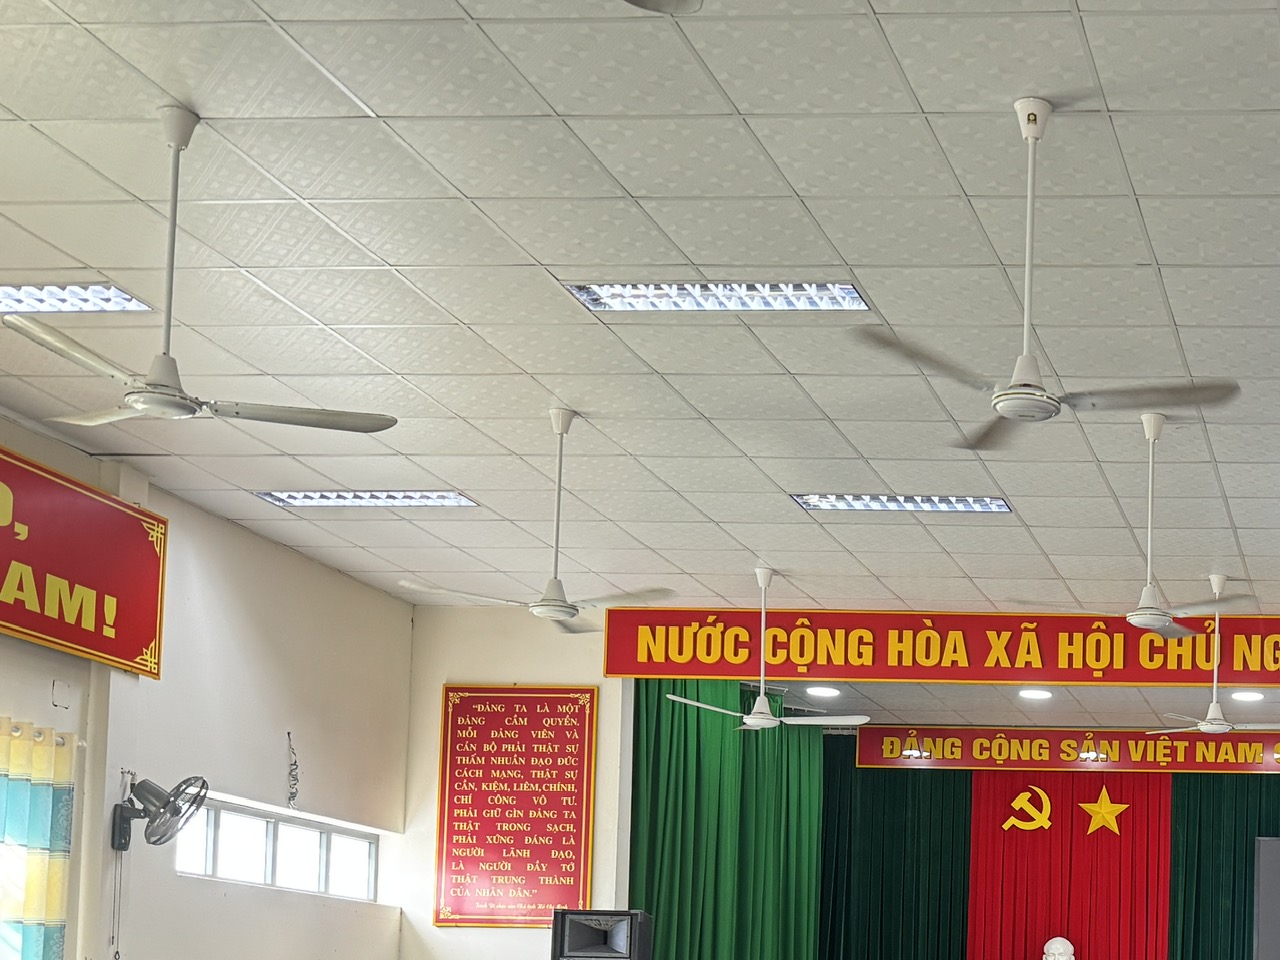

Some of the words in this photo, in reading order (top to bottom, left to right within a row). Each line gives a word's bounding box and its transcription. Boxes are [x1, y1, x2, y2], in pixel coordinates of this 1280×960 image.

[637, 615, 750, 664] NƯỚC
[765, 618, 874, 673] CỘNG
[888, 618, 968, 668] HÒA
[983, 621, 1043, 669] XÃ
[1058, 621, 1124, 677] HỘI
[1138, 620, 1220, 671] CHỦ
[473, 704, 505, 712] “ĐẢNG
[537, 703, 549, 712] LÀ
[558, 703, 580, 713] MỘT
[458, 715, 485, 725] ĐẢNG
[505, 714, 527, 725] CẦM
[543, 715, 579, 727] QUYỀN.
[457, 727, 476, 737] MỖI
[491, 728, 518, 738] ĐẢNG
[531, 729, 554, 738] VIÊN
[566, 729, 579, 738] VÀ
[456, 741, 476, 751] CÁN
[484, 741, 497, 753] BỘ
[502, 742, 525, 752] PHẢI
[532, 743, 559, 754] THẬT
[566, 744, 579, 754] SỰ
[882, 730, 962, 760] ĐẢNG
[972, 733, 1050, 764] CỘNG
[1060, 731, 1121, 763] SẢN
[1129, 730, 1189, 766] VIỆT
[1195, 744, 1263, 764] NAM
[456, 753, 485, 764] THẤM
[491, 754, 525, 764] NHUẦN
[531, 758, 552, 767] ĐẠO
[558, 756, 578, 765] ĐỨC
[455, 768, 482, 777] CÁCH
[491, 770, 523, 779] MẠNG,
[530, 769, 558, 780] THẬT
[565, 770, 578, 780] SỰ
[455, 779, 477, 791] CẦN,
[482, 781, 510, 792] KIỆM,
[514, 781, 541, 792] LIÊM,
[542, 782, 577, 792] CHÍNH,
[454, 794, 472, 804] CHÍ
[488, 794, 516, 804] CÔNG
[533, 795, 547, 805] VÔ
[561, 796, 577, 805] TƯ.
[454, 807, 477, 817] PHẢI
[483, 808, 501, 817] GIỮ
[506, 808, 523, 817] GÌN
[529, 808, 557, 818] ĐẢNG
[453, 821, 480, 832] THẬT
[496, 823, 530, 831] TRONG
[547, 824, 576, 833] SẠCH,
[453, 833, 476, 843] PHẢI
[486, 834, 513, 844] XỨNG
[525, 835, 552, 844] ĐÁNG
[563, 835, 575, 844] LÀ
[452, 847, 484, 856] NGƯỜI
[503, 848, 530, 857] LÃNH
[551, 850, 575, 860] ĐẠO,
[451, 860, 464, 870] LÀ
[479, 861, 511, 870] NGƯỜI
[527, 860, 547, 871] ĐẦY
[561, 862, 575, 871] TỚ
[451, 874, 478, 884] THẬT
[491, 876, 525, 885] TRUNG
[539, 875, 573, 884] THÀNH
[450, 886, 470, 897] CỦA
[475, 887, 503, 896] NHÂN
[509, 887, 537, 898] DÂN.”
